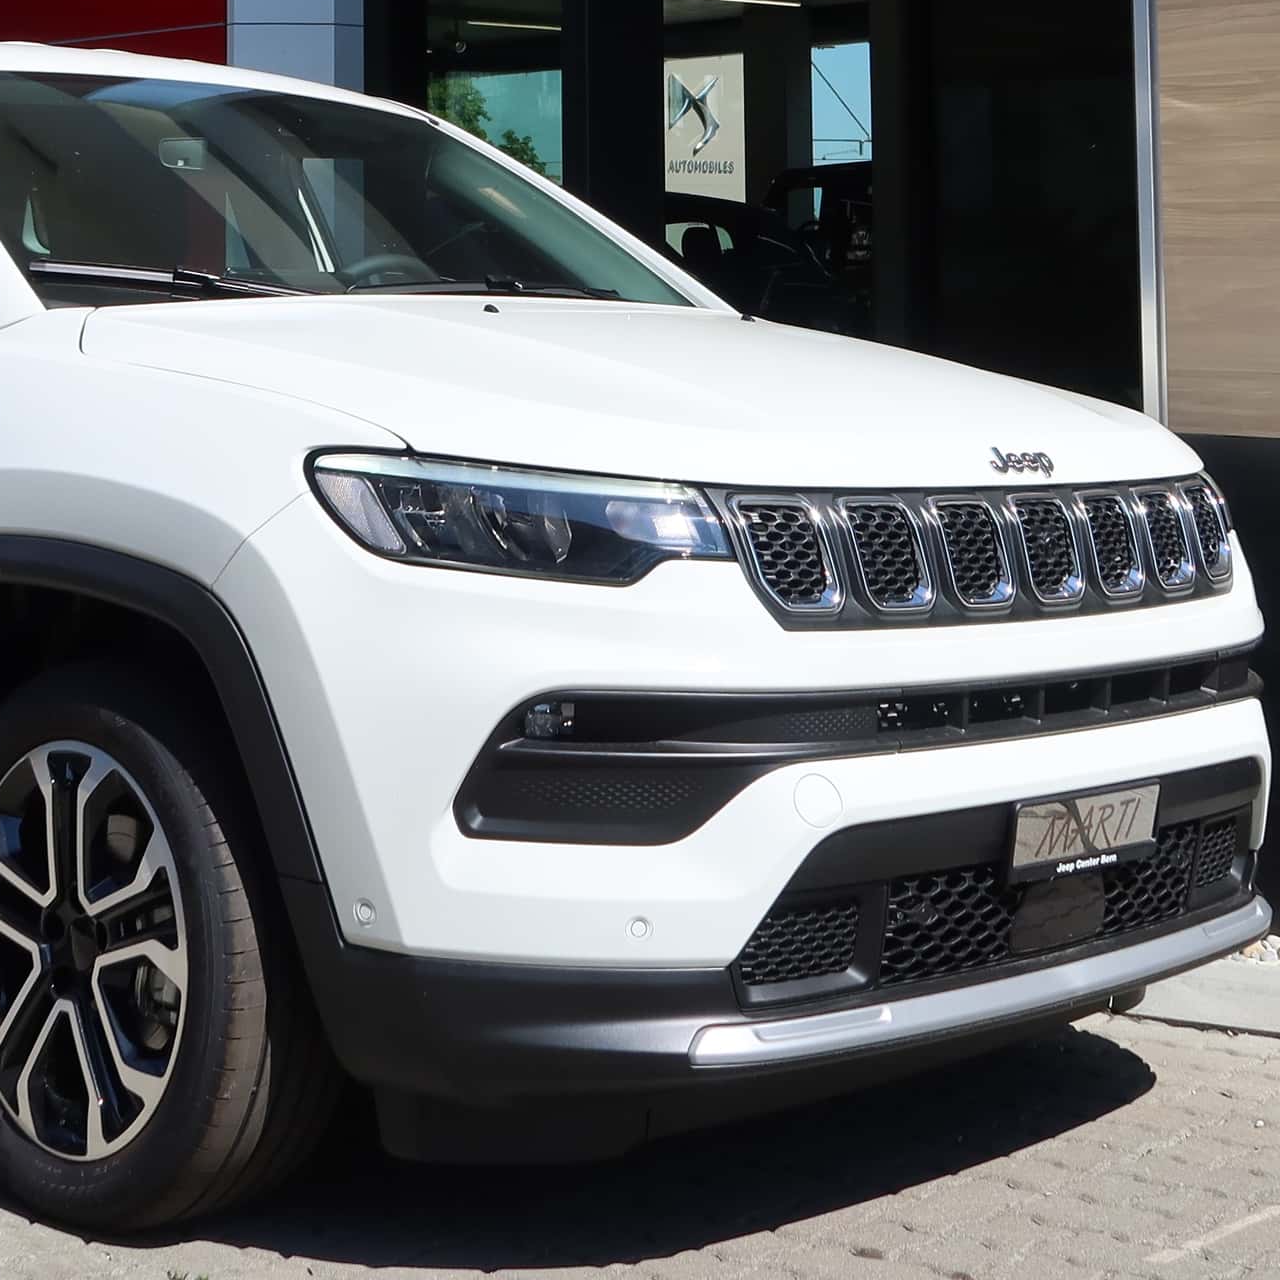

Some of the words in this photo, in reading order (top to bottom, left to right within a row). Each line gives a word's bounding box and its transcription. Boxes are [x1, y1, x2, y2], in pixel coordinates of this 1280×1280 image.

[667, 159, 736, 175] AUTOMOBILES
[990, 446, 1055, 479] Jeep
[1034, 796, 1142, 858] MARTI
[1056, 862, 1075, 873] Jeep
[1076, 857, 1100, 870] Center
[1100, 853, 1118, 865] Bern
